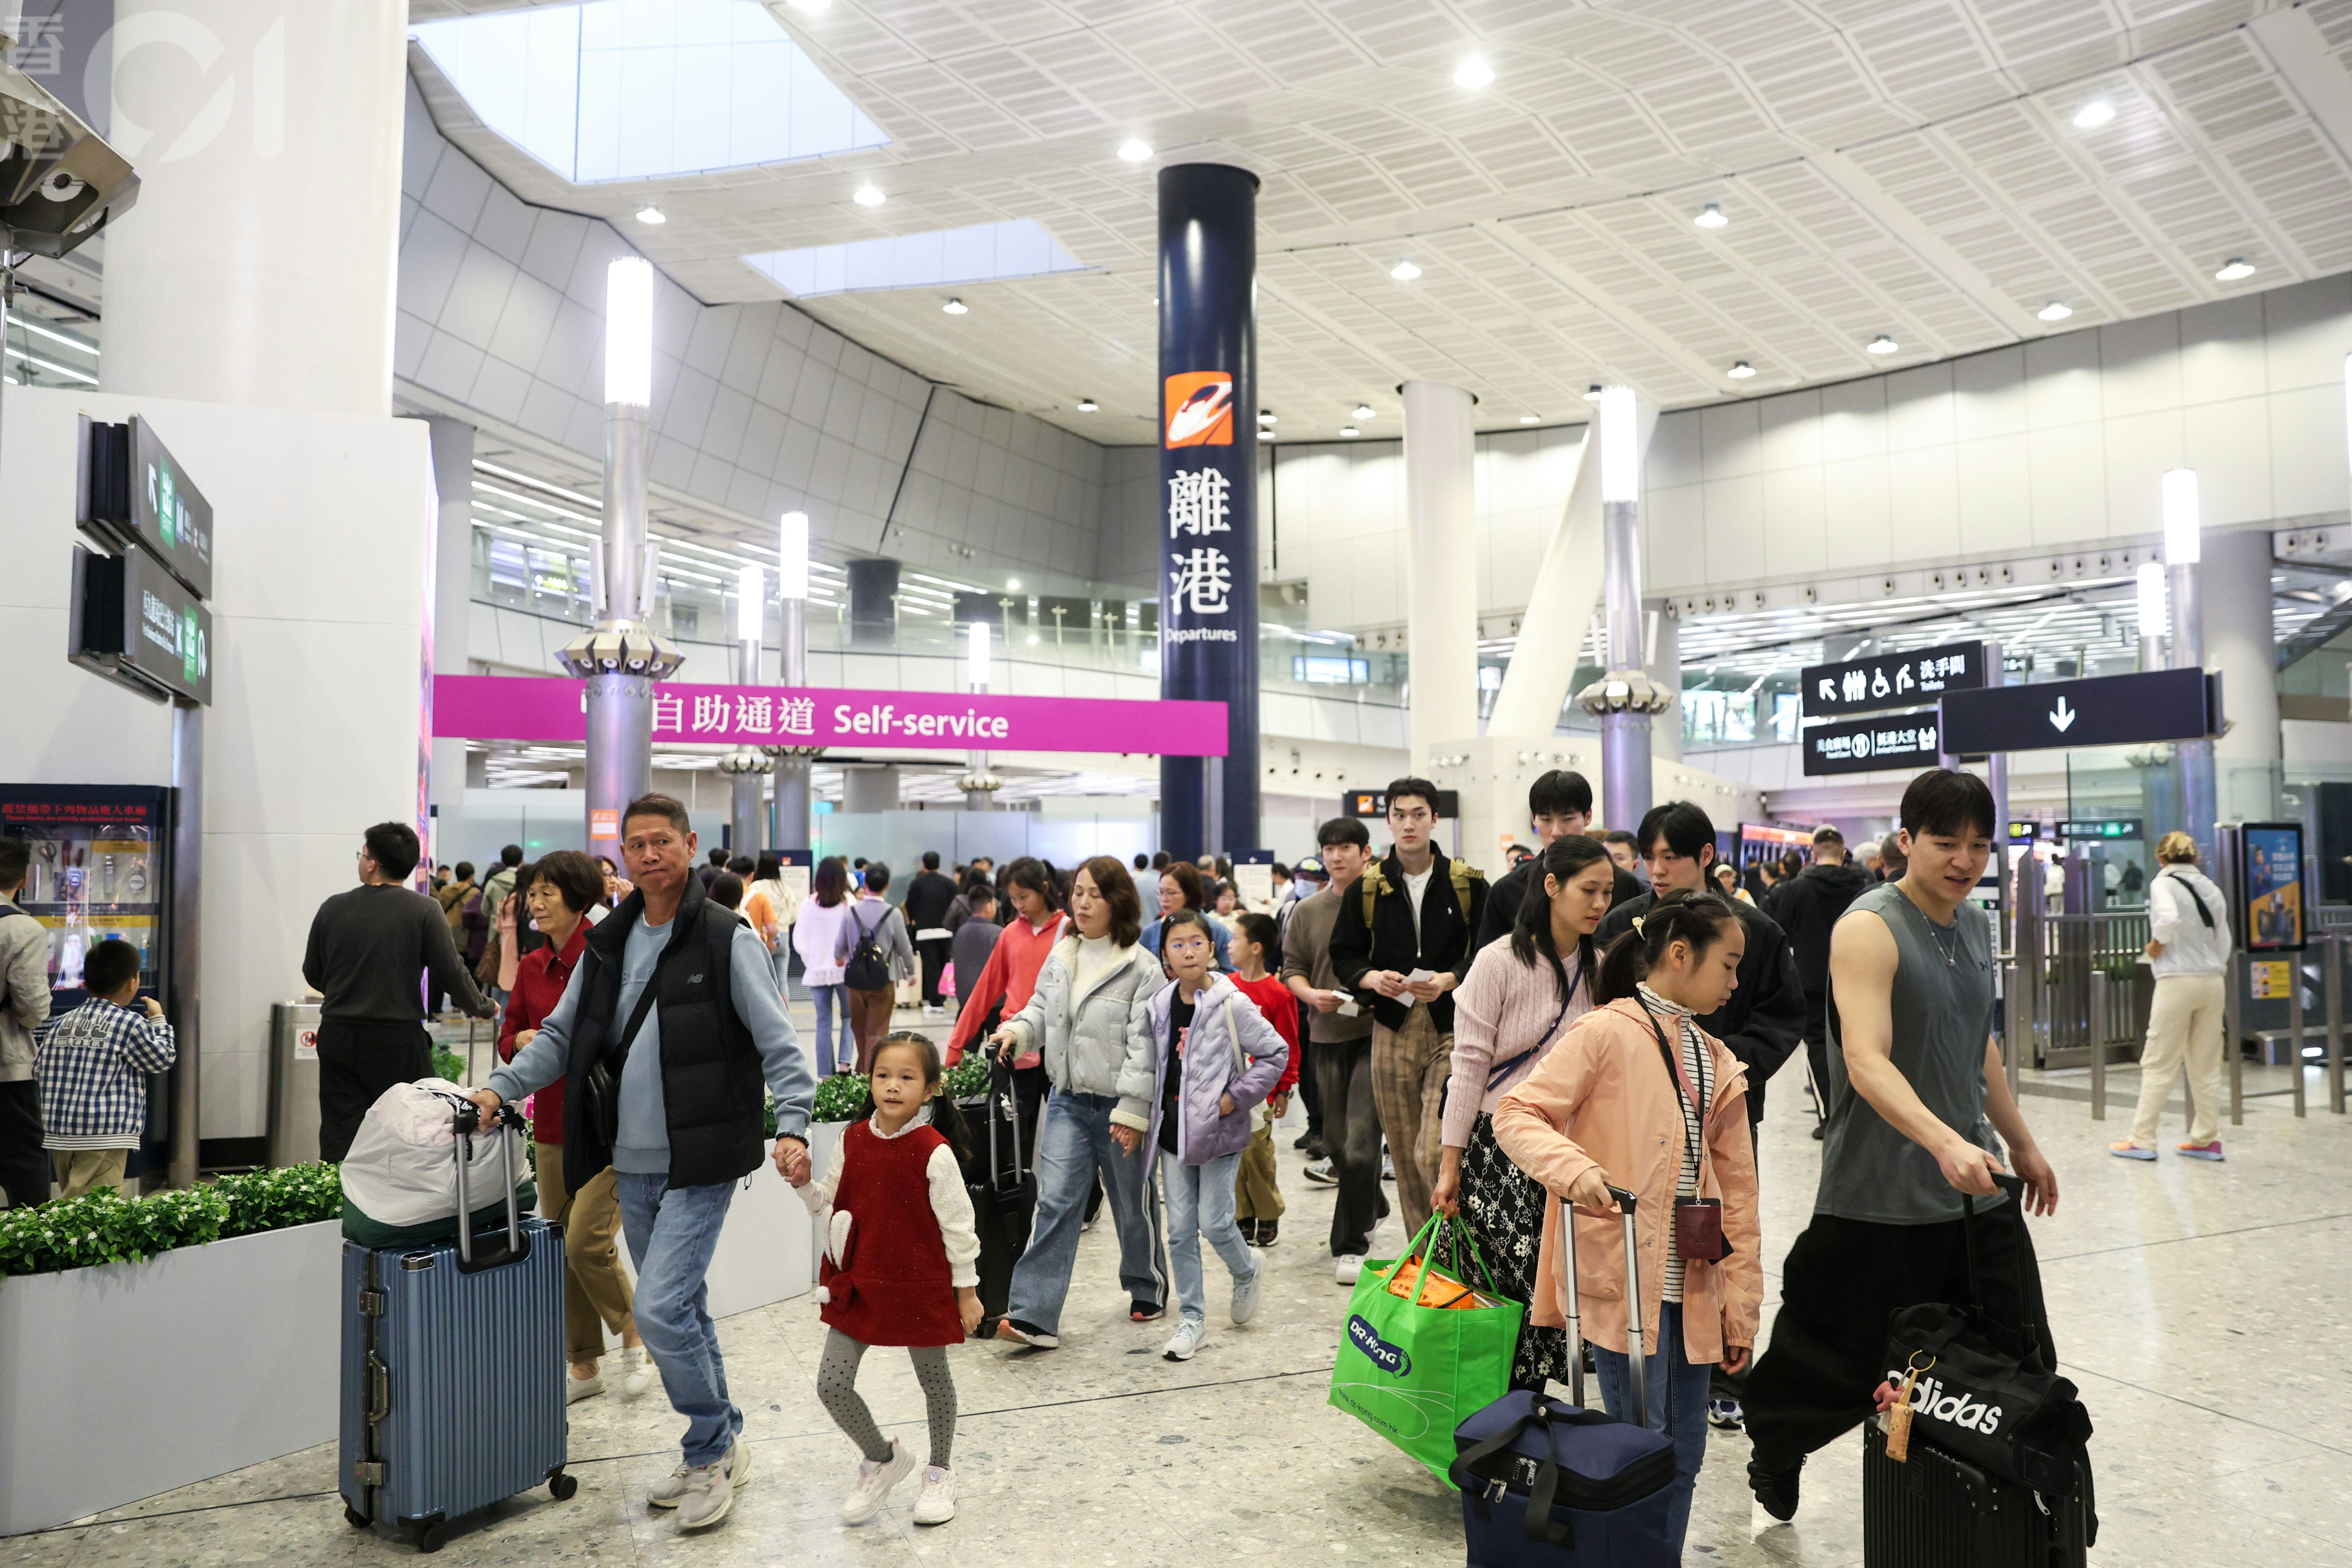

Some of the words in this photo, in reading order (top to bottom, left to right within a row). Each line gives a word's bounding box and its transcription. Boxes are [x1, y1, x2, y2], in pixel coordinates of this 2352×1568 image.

[1168, 467, 1232, 615] 離港
[1164, 627, 1237, 645] Departures
[1920, 654, 1965, 680] 洗手間
[1920, 680, 1945, 692] Toilets
[652, 692, 815, 735] 自助通道
[833, 704, 1009, 738] Self-service
